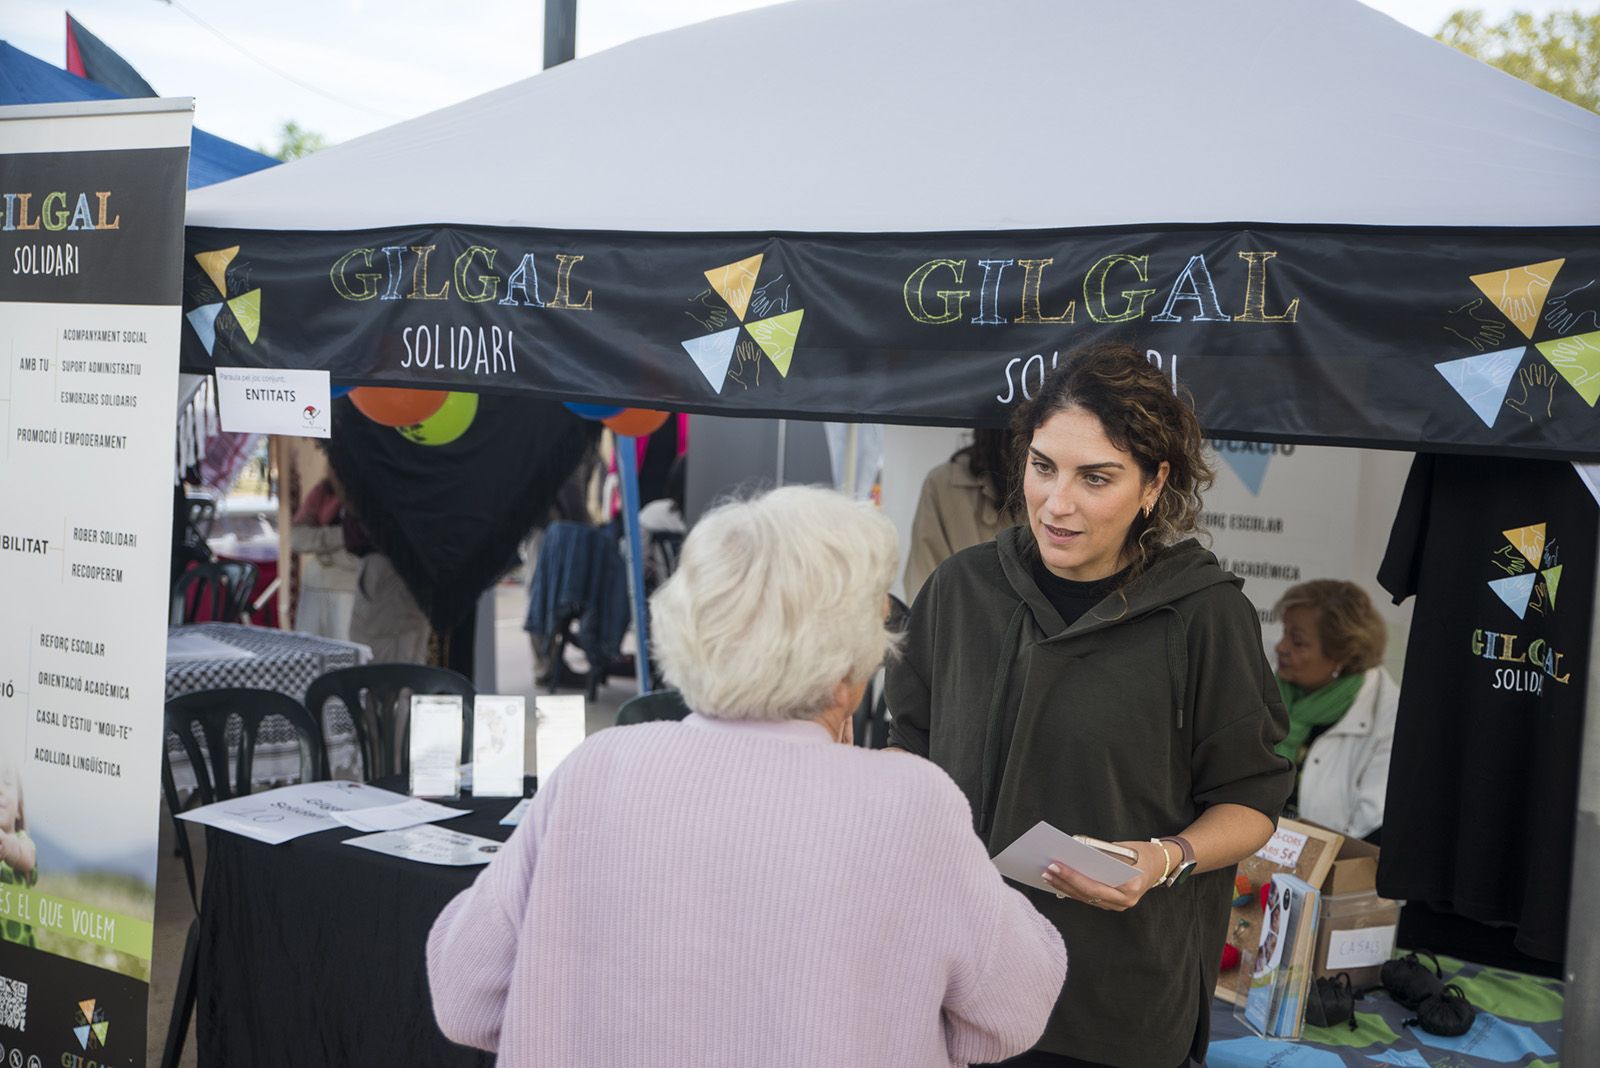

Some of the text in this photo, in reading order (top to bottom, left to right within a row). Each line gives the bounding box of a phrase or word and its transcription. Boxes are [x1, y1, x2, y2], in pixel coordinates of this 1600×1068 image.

[0, 191, 120, 231] ILGAL
[13, 243, 79, 277] SOLIDARI
[329, 244, 593, 311] GILGAL
[903, 251, 1300, 325] GILGAL
[63, 329, 148, 344] ACOMPANYAMENT SOCIAL
[400, 323, 517, 375] SOLIDARI
[19, 357, 49, 372] AMB TU
[62, 360, 142, 376] SUPORT ADMINISTRATIU
[60, 391, 137, 408] ESMORZARS SOLIDARIS
[245, 388, 296, 403] ENTITATS
[17, 427, 127, 449] PROMOCIÓ I EMPODERAMENT
[1229, 514, 1284, 534] ESCOLAR
[73, 527, 138, 548] ROBER SOLIDARI
[71, 563, 123, 583] RECOOPEREM
[40, 633, 105, 656] REFORÇ ESCOLAR
[0, 679, 14, 698] IÓ
[38, 671, 83, 692] ORIENTACIÓ
[36, 709, 60, 727] CASAL
[62, 714, 92, 733] D'ESTIU
[34, 747, 122, 777] ACOLLIDA LINGÜÍSTICA
[18, 893, 31, 920] EL
[39, 897, 64, 929] QUE
[71, 908, 116, 944] VOLEM
